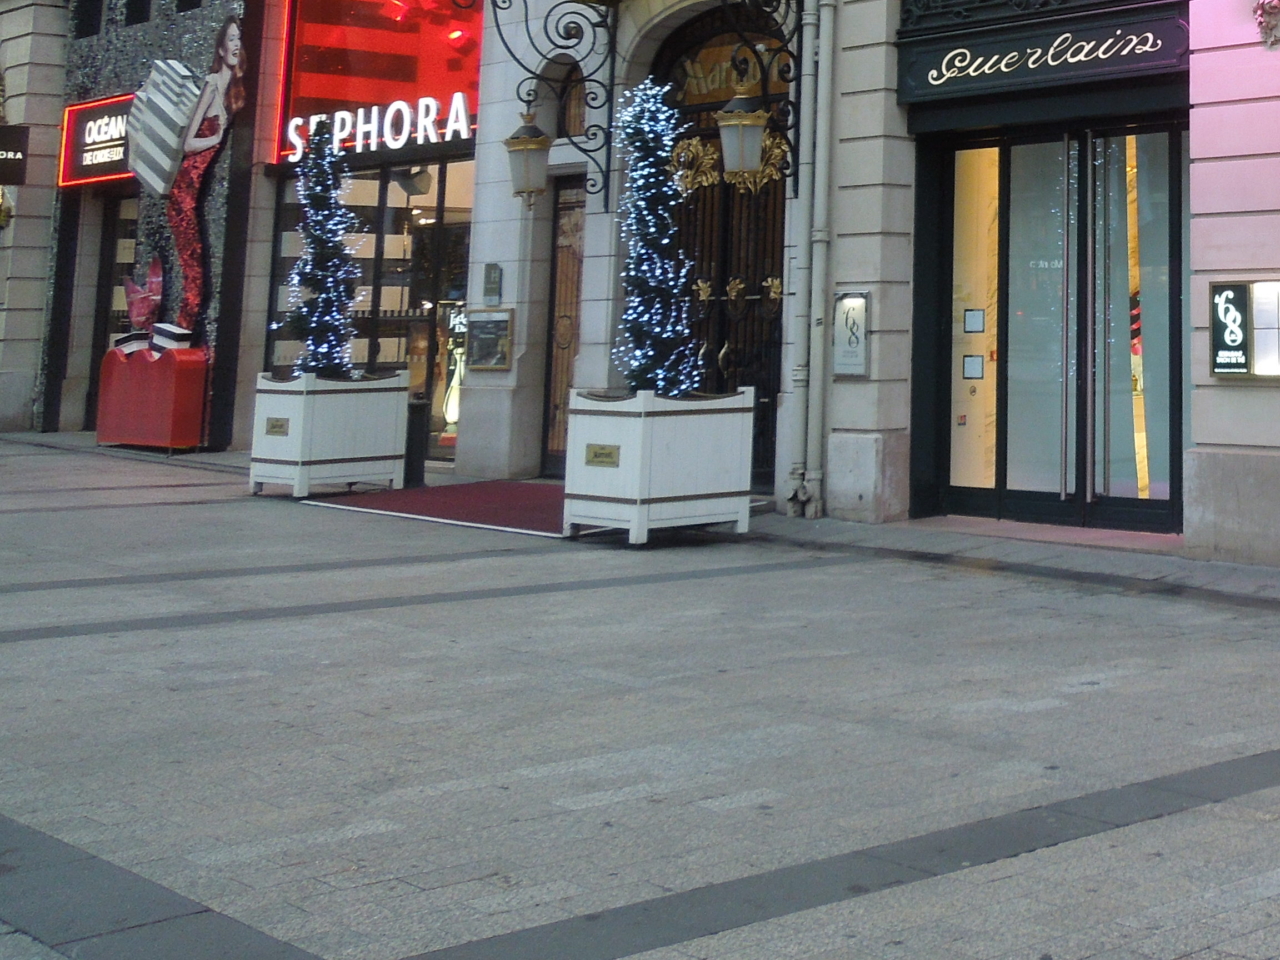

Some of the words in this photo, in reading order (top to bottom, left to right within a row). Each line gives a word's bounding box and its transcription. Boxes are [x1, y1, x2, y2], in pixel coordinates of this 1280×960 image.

[927, 28, 1163, 86] Guerlain
[84, 114, 128, 144] OCÉAN
[82, 151, 94, 166] DE
